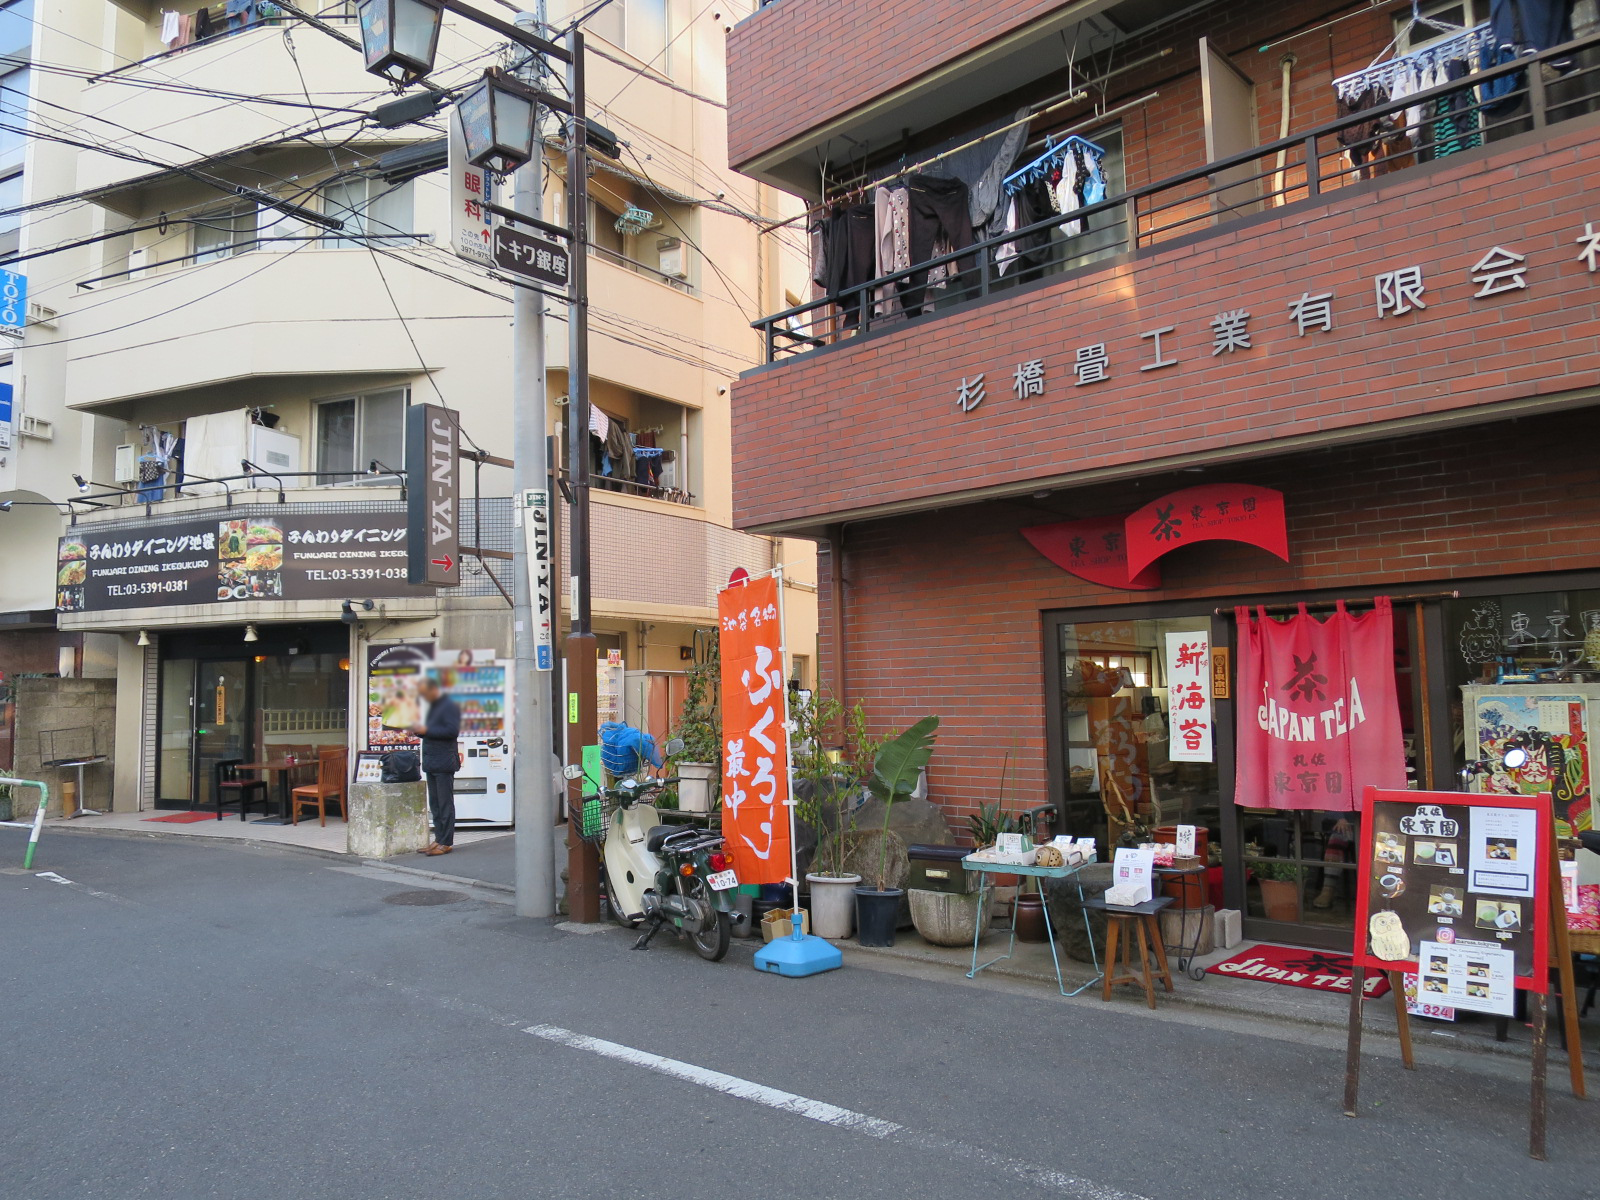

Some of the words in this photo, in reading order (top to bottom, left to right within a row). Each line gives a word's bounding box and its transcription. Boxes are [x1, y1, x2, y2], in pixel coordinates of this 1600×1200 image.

[496, 234, 567, 277] トキワ銀座
[2, 270, 19, 324] TOTO
[431, 418, 452, 546] JIN-YA
[287, 527, 408, 544] ふんわりダイニング
[1150, 503, 1182, 541] 茶
[1191, 521, 1204, 529] TEA
[1207, 518, 1224, 526] SHOP
[92, 566, 127, 578] FUNWARI
[128, 563, 159, 575] DINING
[161, 559, 209, 572] IKEBUKURO
[293, 551, 337, 560] FUNWARI
[339, 550, 376, 559] DINING
[107, 579, 189, 597] TEL:03-5391-0381
[723, 603, 777, 632] 池袋名物
[1281, 650, 1329, 703] 茶
[1175, 642, 1207, 751] 新海苔
[1257, 681, 1316, 742] JAPAN
[1320, 676, 1367, 741] TEA
[741, 645, 781, 860] ふくろう
[724, 738, 750, 821] 最中
[1218, 957, 1305, 983] JAPAN
[1423, 1004, 1449, 1018] 324
